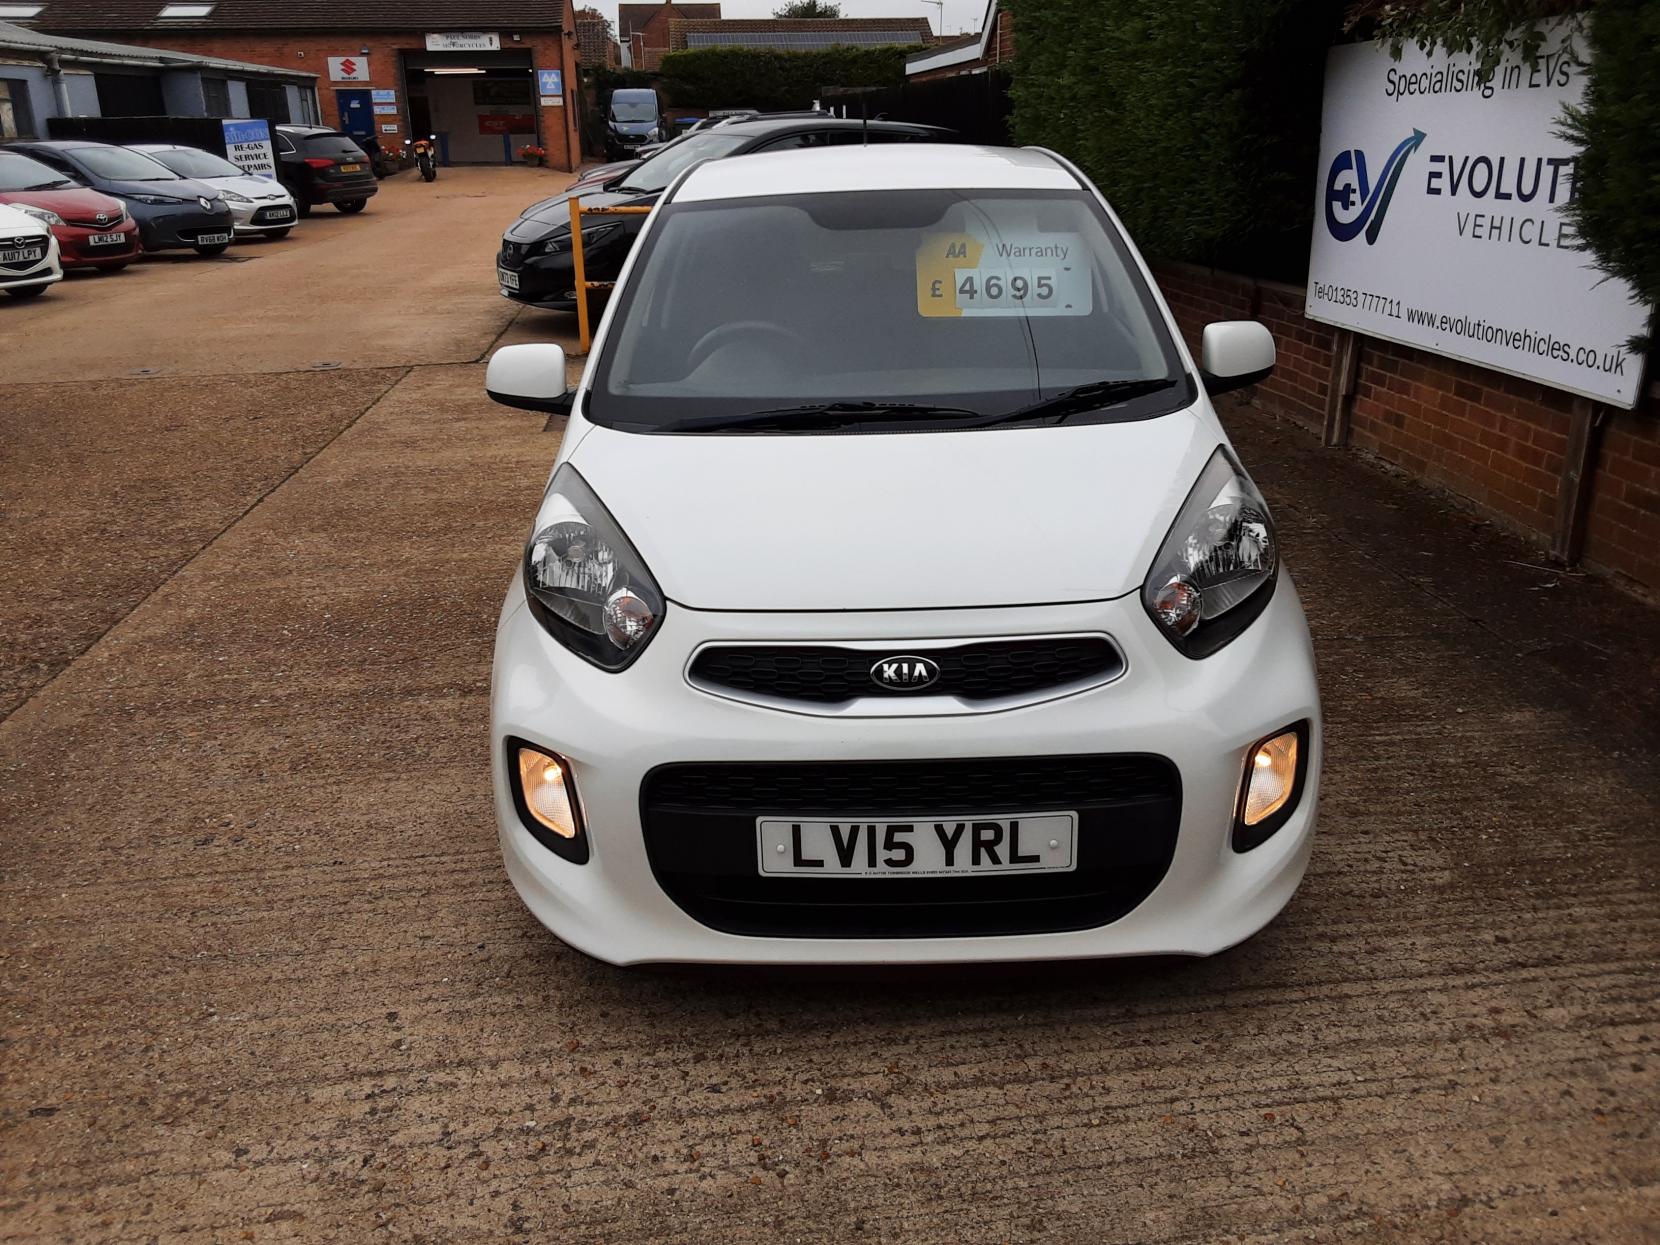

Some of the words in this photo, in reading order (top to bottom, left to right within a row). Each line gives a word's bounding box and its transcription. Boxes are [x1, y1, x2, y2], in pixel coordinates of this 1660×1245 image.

[1385, 61, 1495, 102] Specialising
[1501, 58, 1521, 89] in
[1528, 53, 1571, 89] EVs
[234, 143, 264, 152] RE-GAS
[234, 153, 269, 162] SERVICE
[240, 163, 273, 172] EPAIRS
[1456, 211, 1580, 250] VEHICLE
[2, 250, 20, 262] AU17
[22, 249, 37, 259] LPY
[945, 242, 967, 258] AA
[996, 243, 1069, 260] Warranty
[930, 280, 943, 298] £
[958, 275, 1054, 300] 4695
[1313, 281, 1359, 308] Tel-01353
[1362, 292, 1402, 319] 777711
[1406, 306, 1627, 377] www.evolutionvehicles.co.uk
[882, 663, 930, 683] KIA
[791, 823, 915, 869] LV15
[933, 820, 1041, 867] YRL
